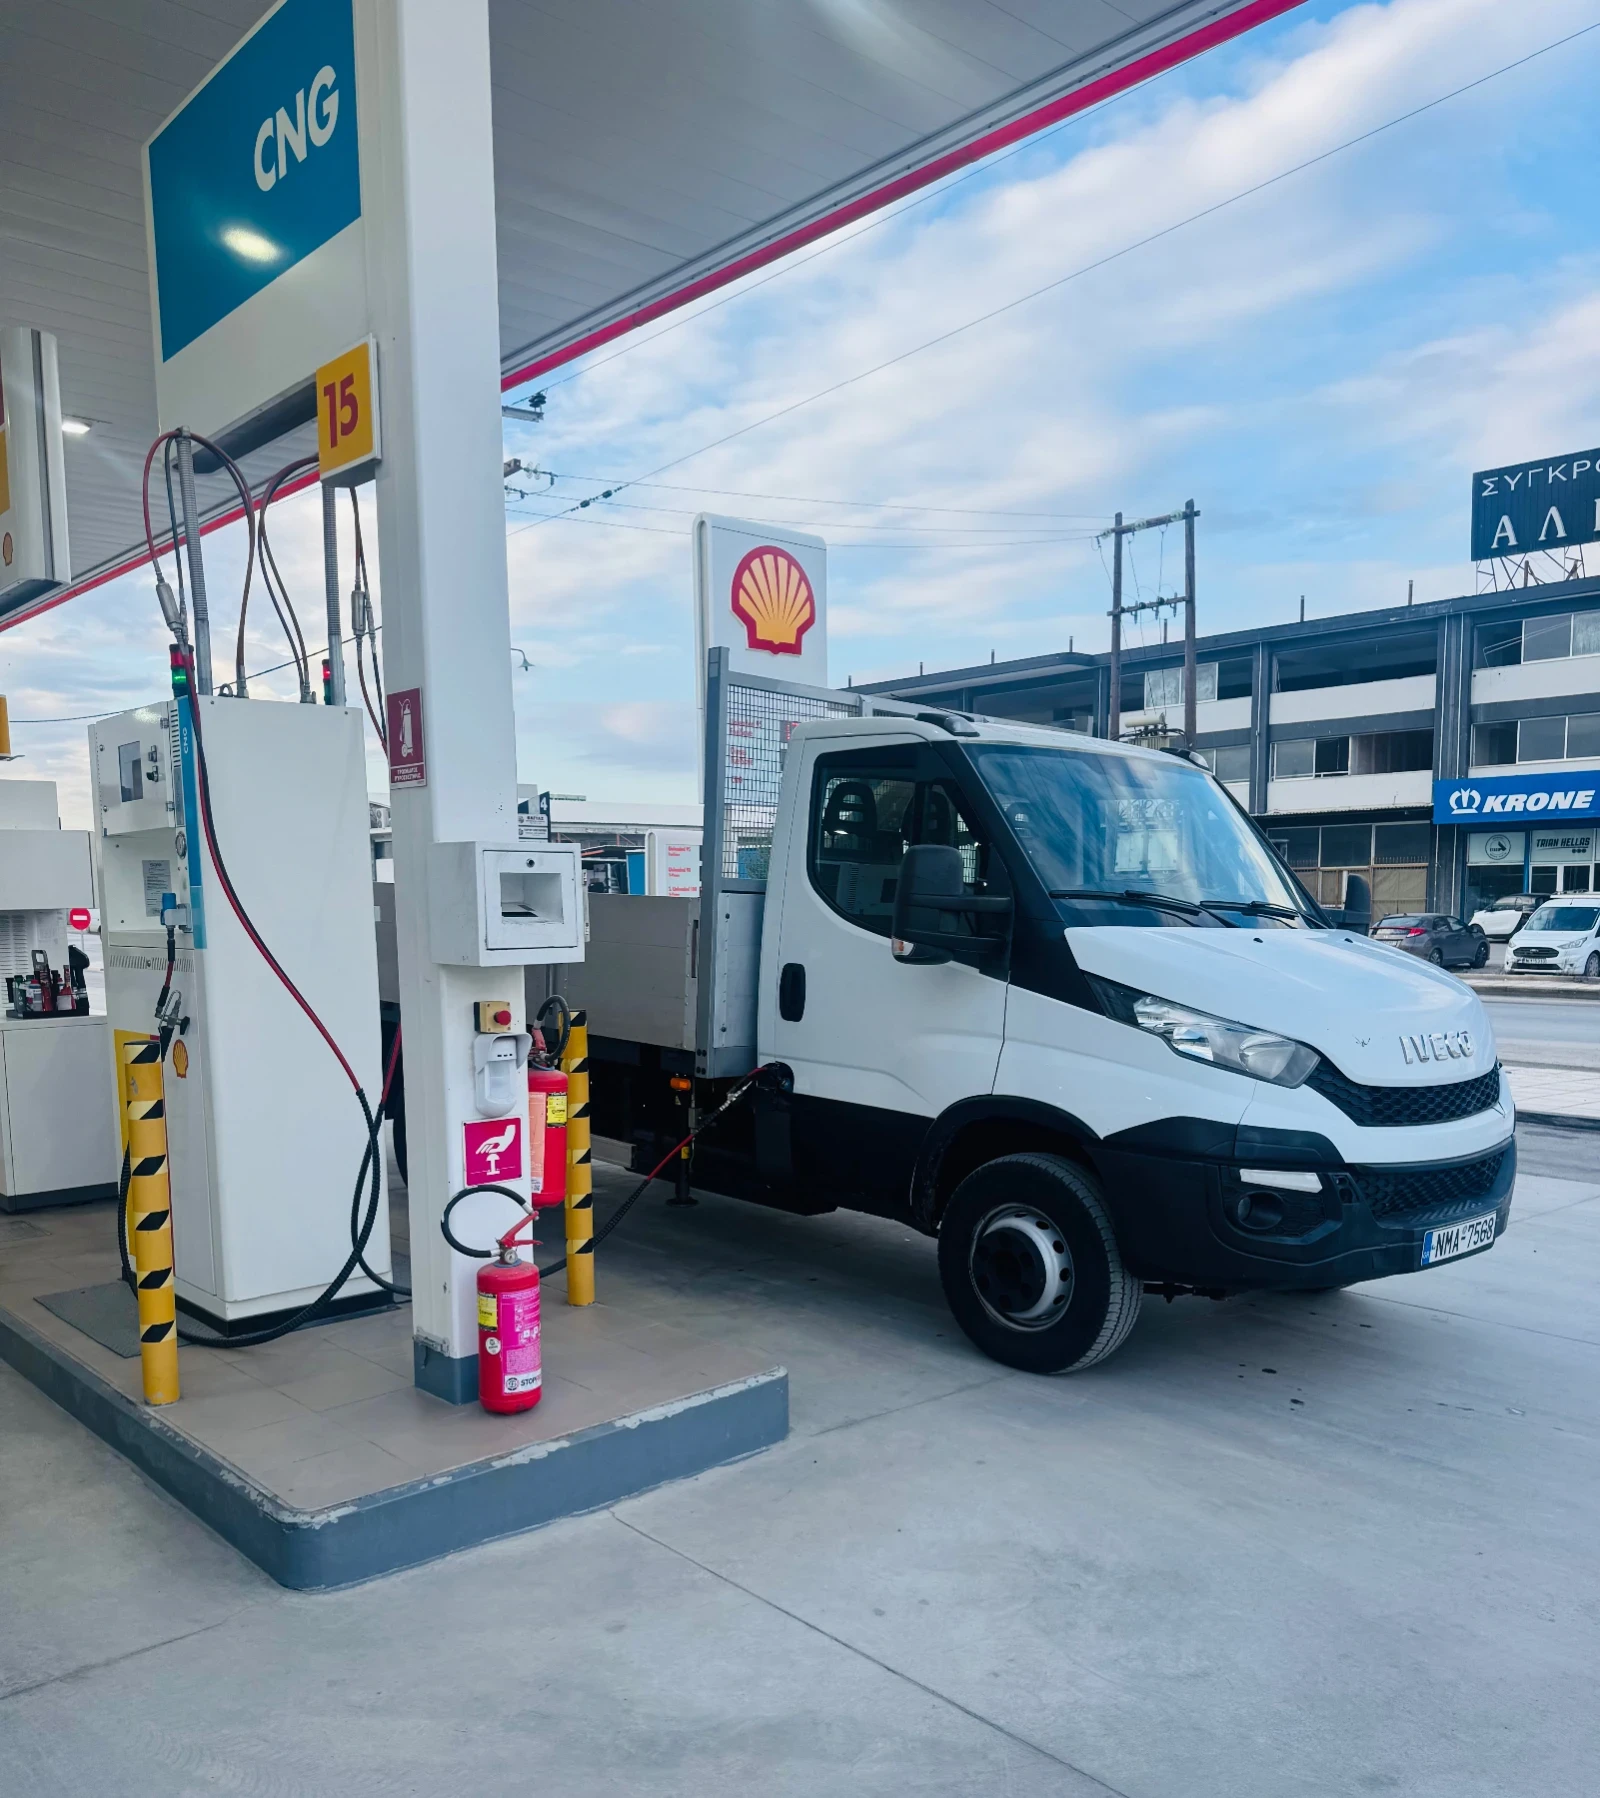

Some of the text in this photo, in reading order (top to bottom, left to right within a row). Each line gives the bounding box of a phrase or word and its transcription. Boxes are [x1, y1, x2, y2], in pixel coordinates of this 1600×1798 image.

[254, 65, 339, 192] CNG
[323, 372, 358, 449] 15
[1481, 459, 1600, 497] ΣΥΓΚΡ
[540, 796, 548, 811] 4
[1482, 790, 1595, 813] KRONE
[1561, 837, 1591, 847] HELLAS
[1399, 1031, 1474, 1064] IVECO
